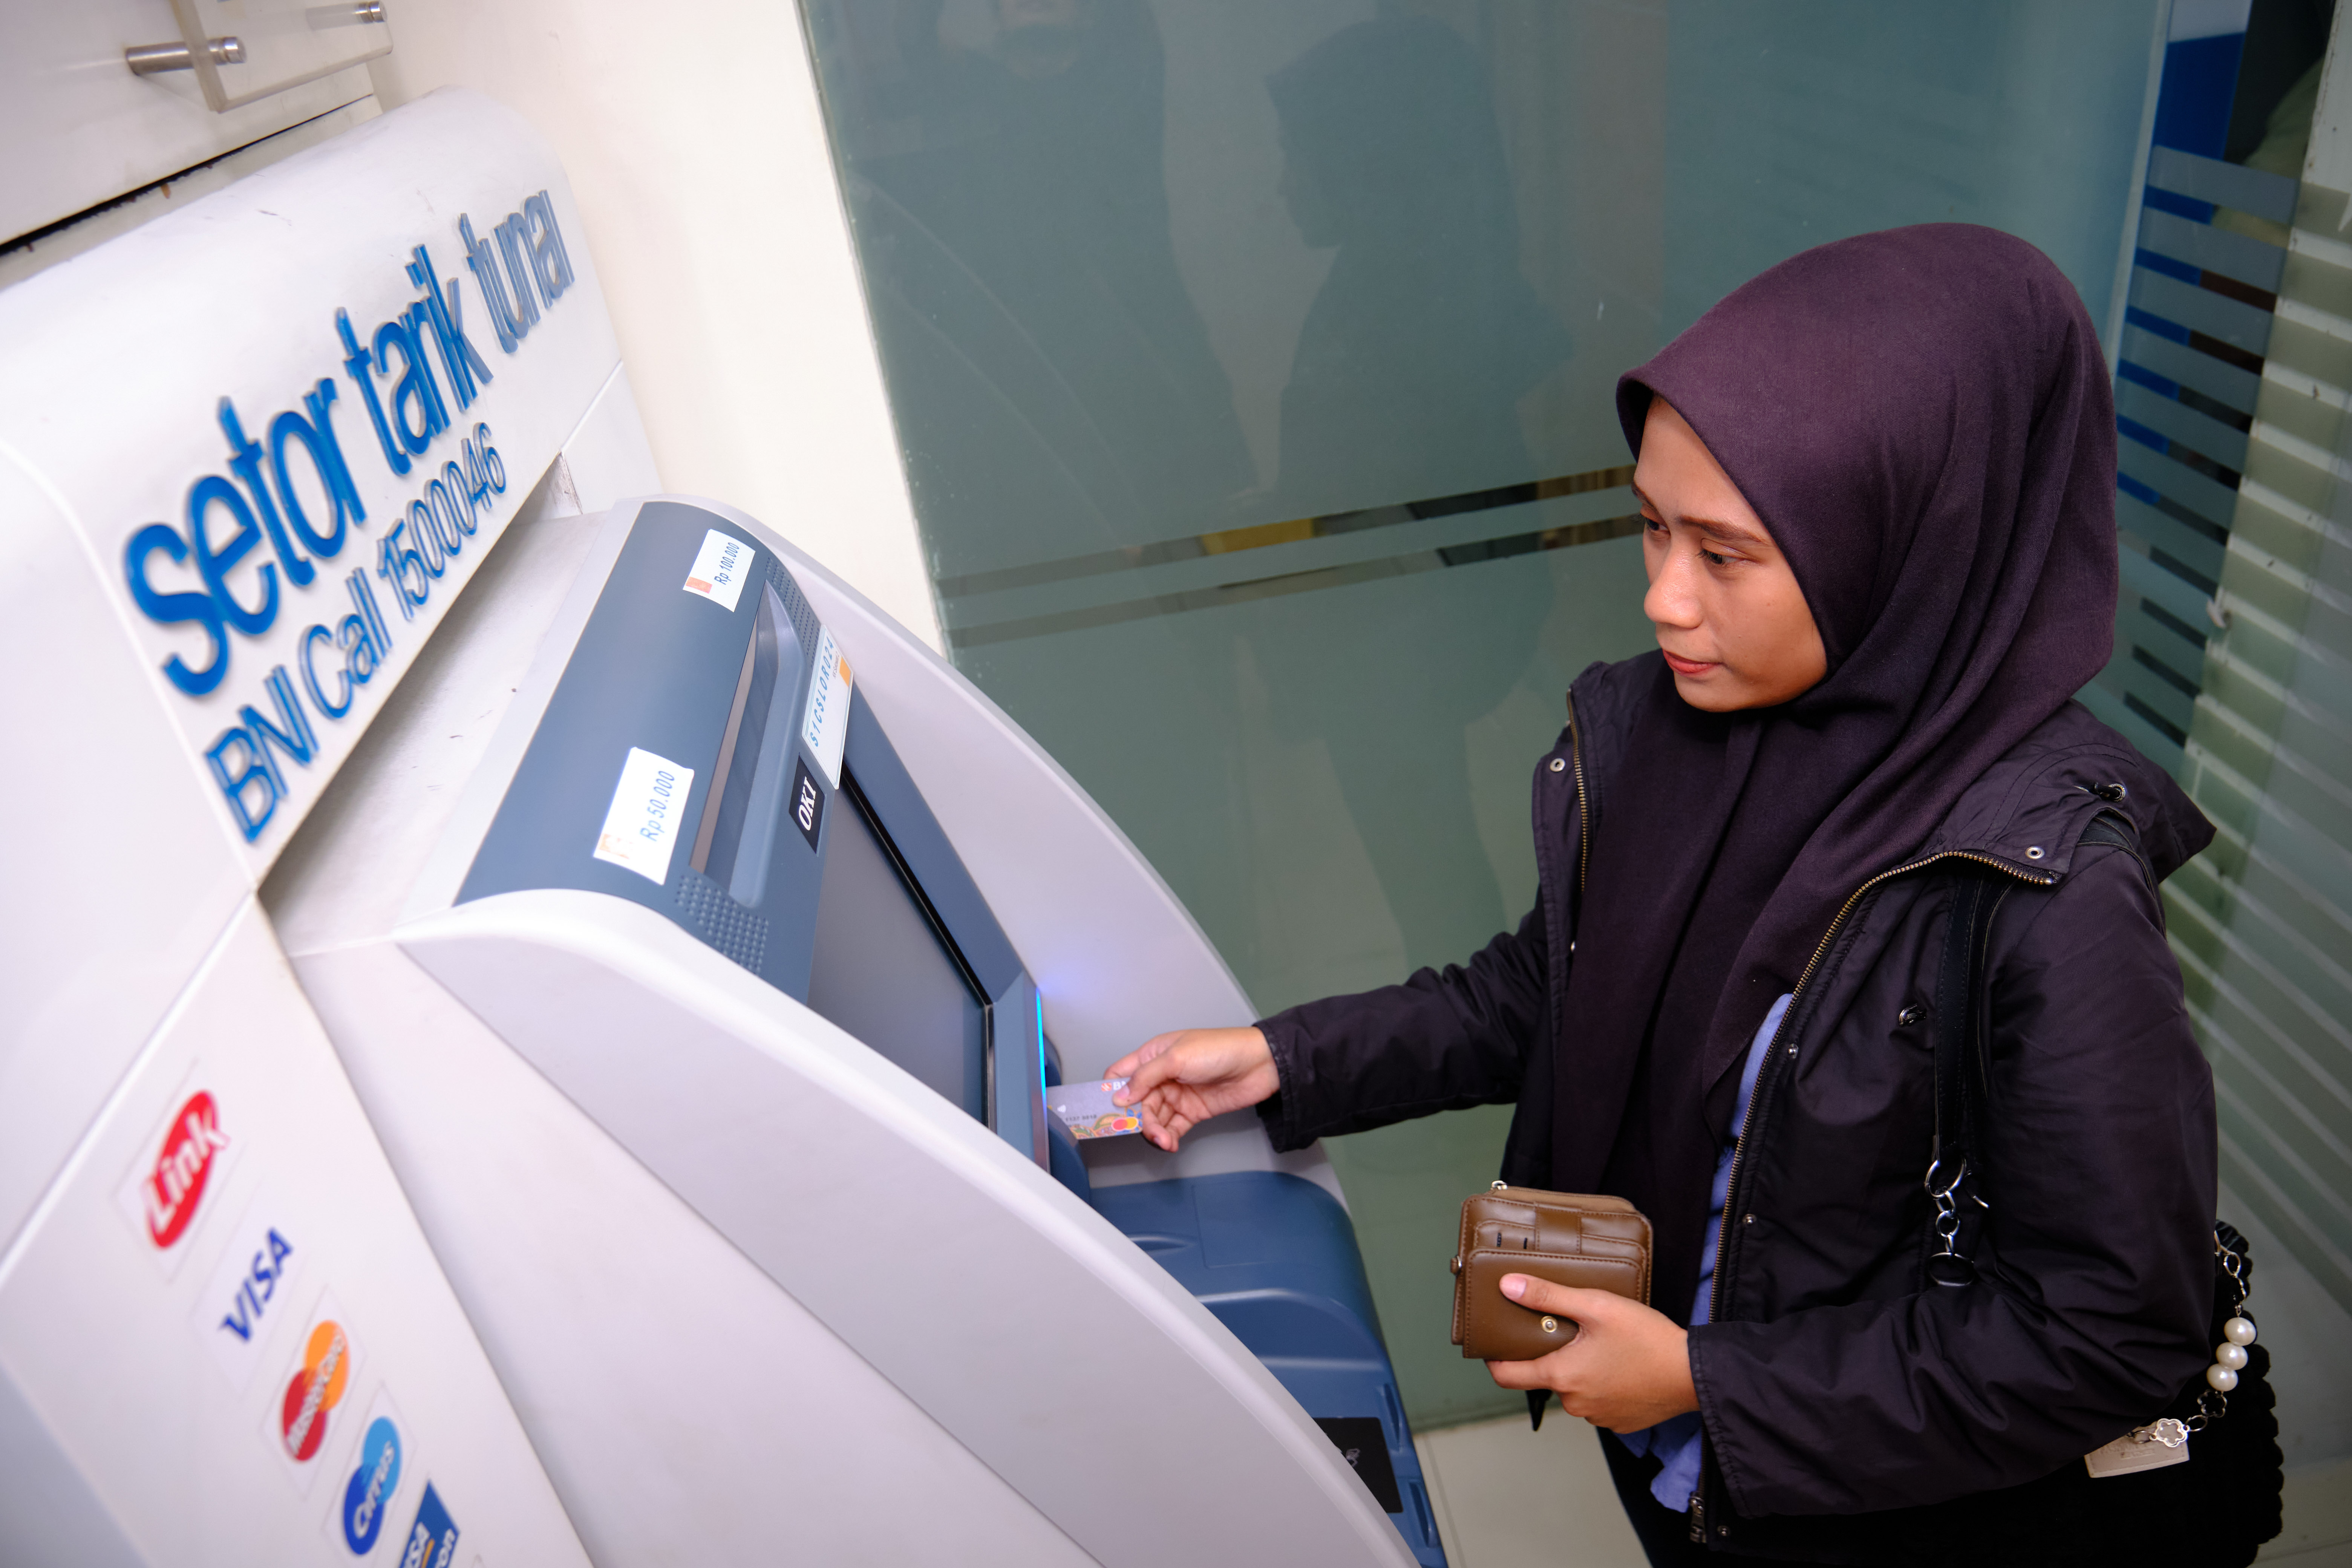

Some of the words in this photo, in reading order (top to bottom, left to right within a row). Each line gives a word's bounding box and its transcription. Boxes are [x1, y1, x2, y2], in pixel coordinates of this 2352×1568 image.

[123, 378, 368, 697] setor
[335, 243, 495, 476] tarik
[459, 190, 576, 354] tunai
[714, 572, 732, 586] Rp
[719, 542, 740, 572] 100.000
[204, 665, 320, 843] BNI
[298, 568, 393, 719] Call
[377, 423, 507, 621] 1500046
[646, 770, 675, 819] 50.000
[798, 776, 816, 831] OKI
[639, 819, 666, 842] Rp
[139, 1110, 231, 1234] Link
[217, 1227, 292, 1342] VISA
